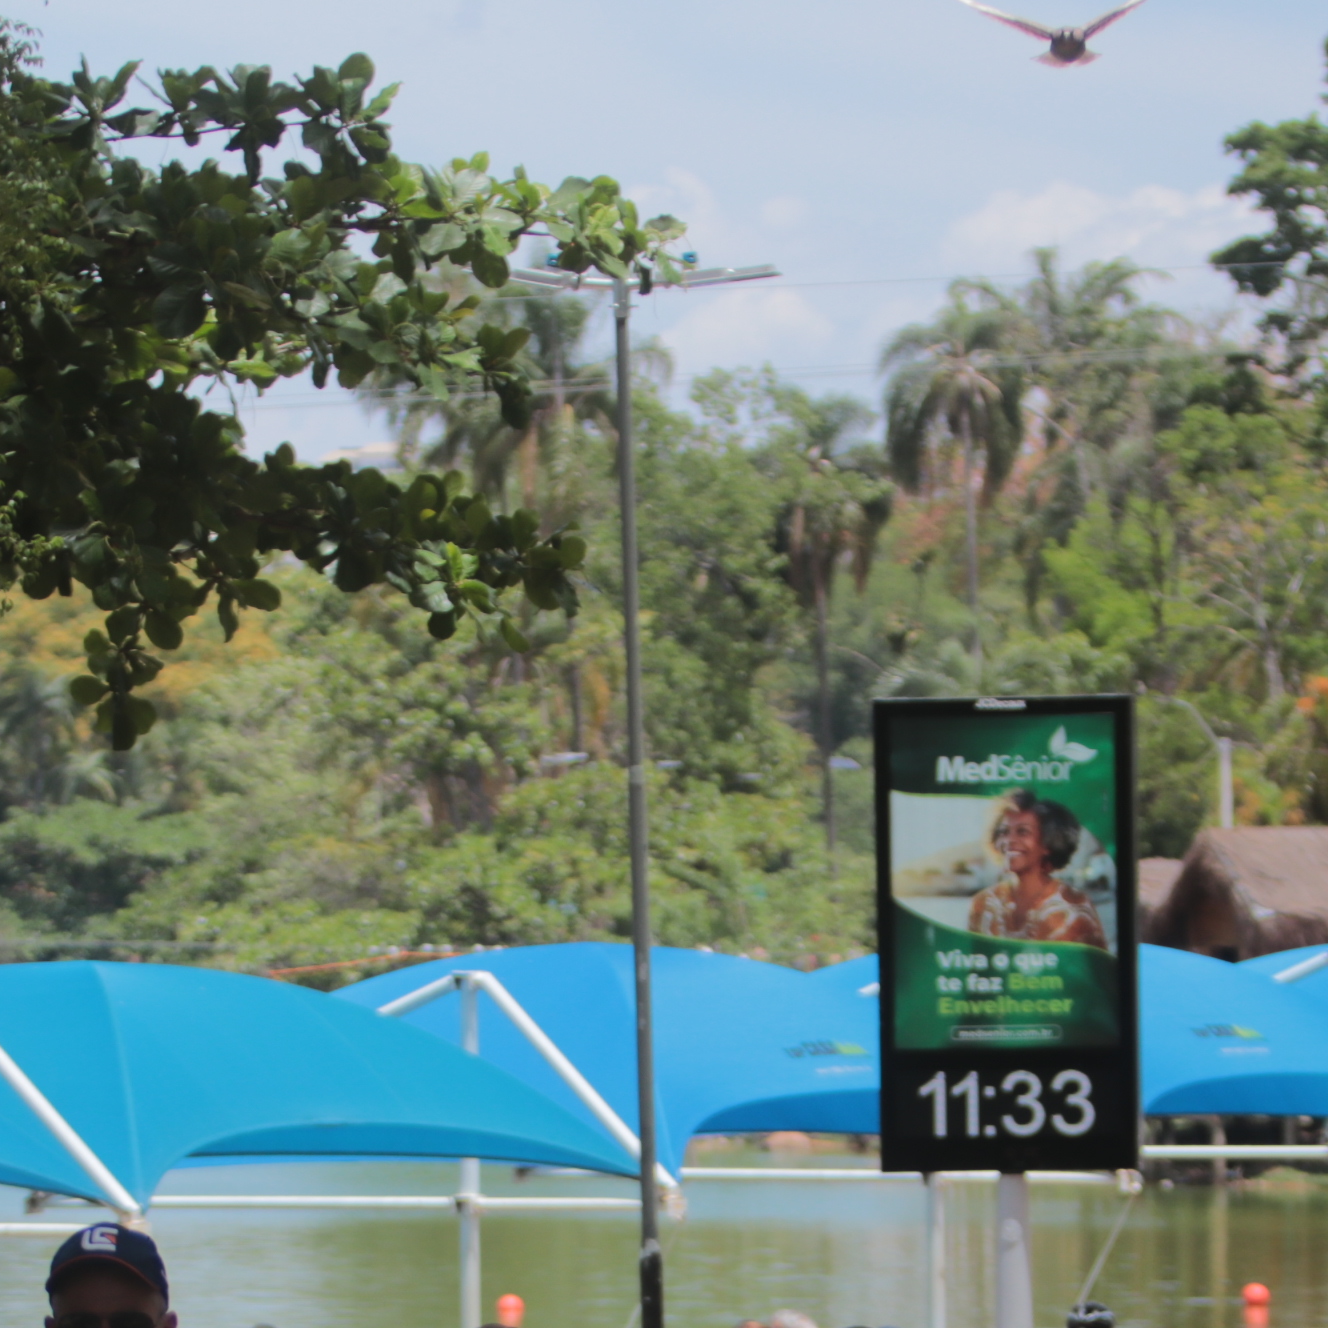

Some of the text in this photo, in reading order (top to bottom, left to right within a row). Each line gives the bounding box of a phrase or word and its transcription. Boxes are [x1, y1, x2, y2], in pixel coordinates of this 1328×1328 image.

[936, 754, 1073, 783] MedSênior
[936, 949, 1059, 975] Viva o que
[937, 973, 1064, 993] te faz Bem
[938, 995, 1074, 1014] Envelhecer
[918, 1068, 1097, 1138] 11:33
